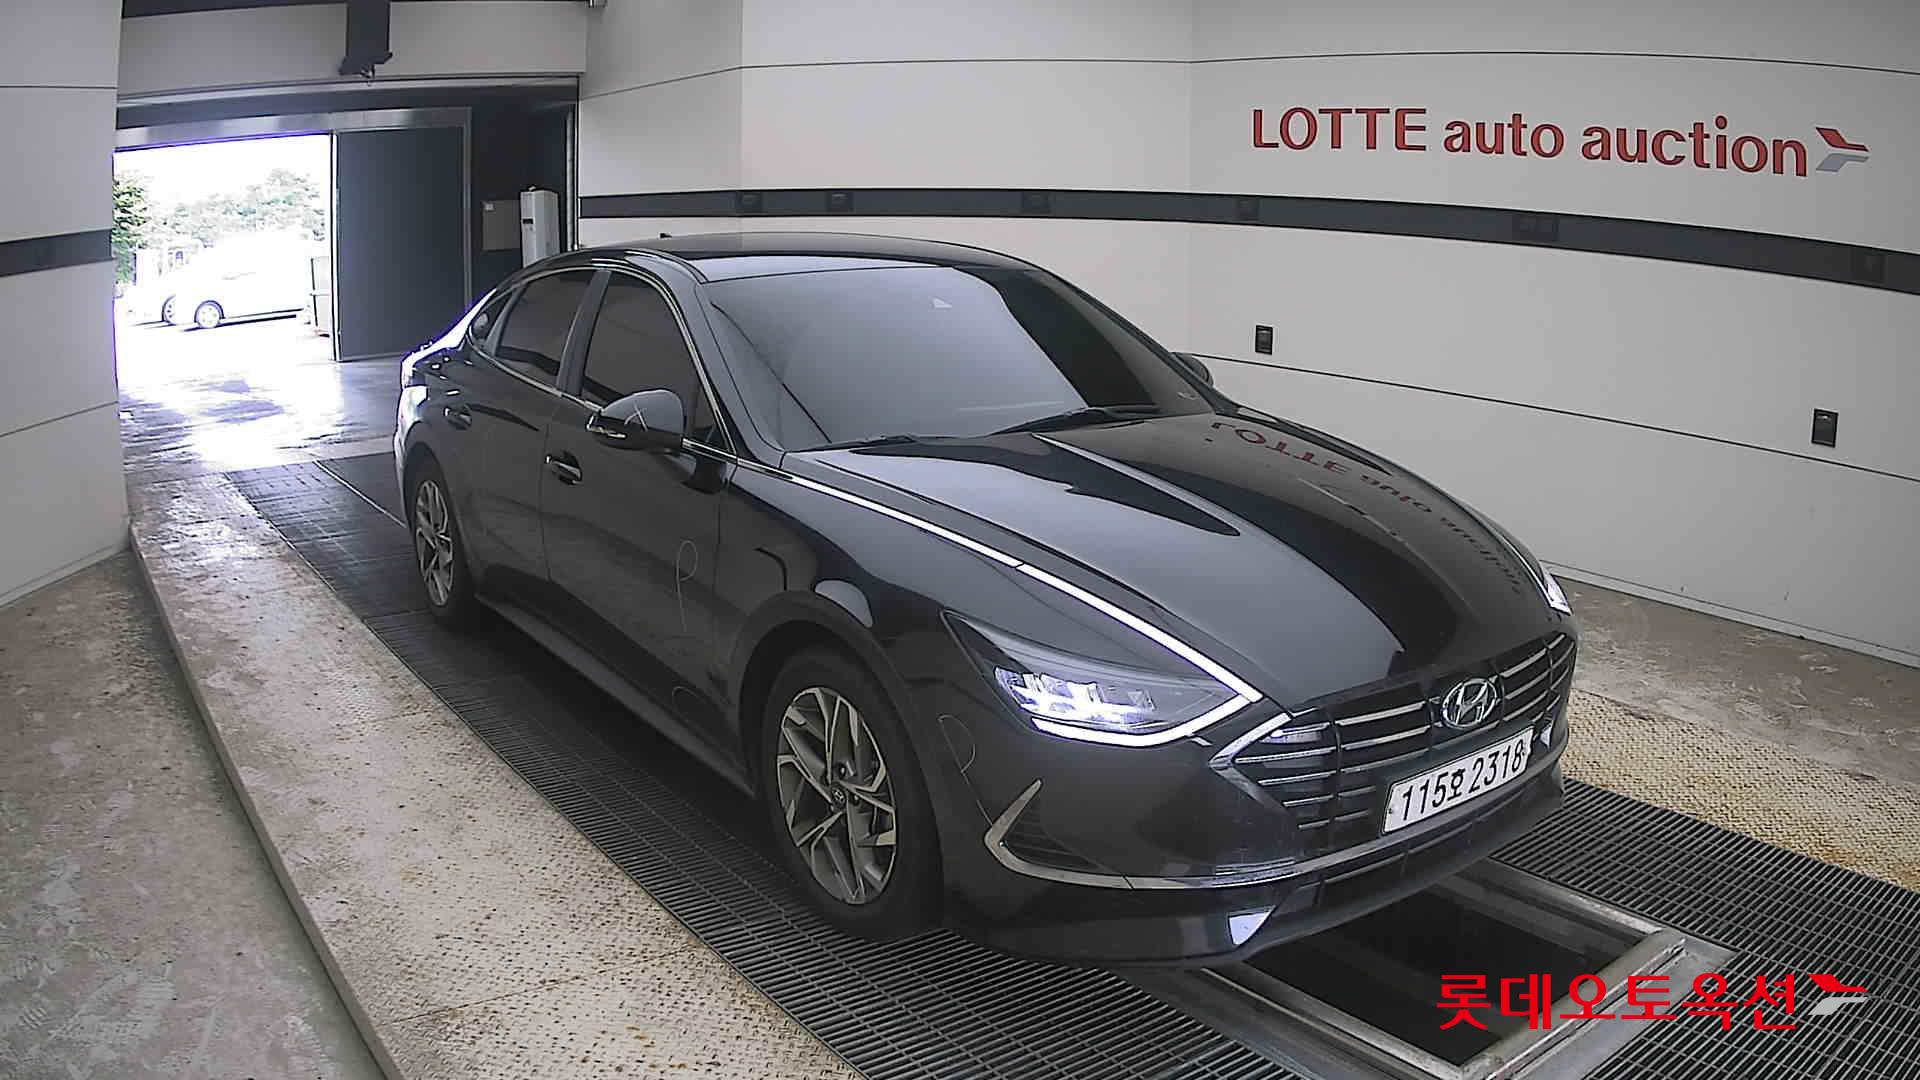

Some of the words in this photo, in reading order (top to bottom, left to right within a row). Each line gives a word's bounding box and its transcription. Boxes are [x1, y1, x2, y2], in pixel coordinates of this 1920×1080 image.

[1252, 107, 1427, 152] LOTTE
[1443, 112, 1566, 158] auto
[1580, 114, 1808, 177] auction
